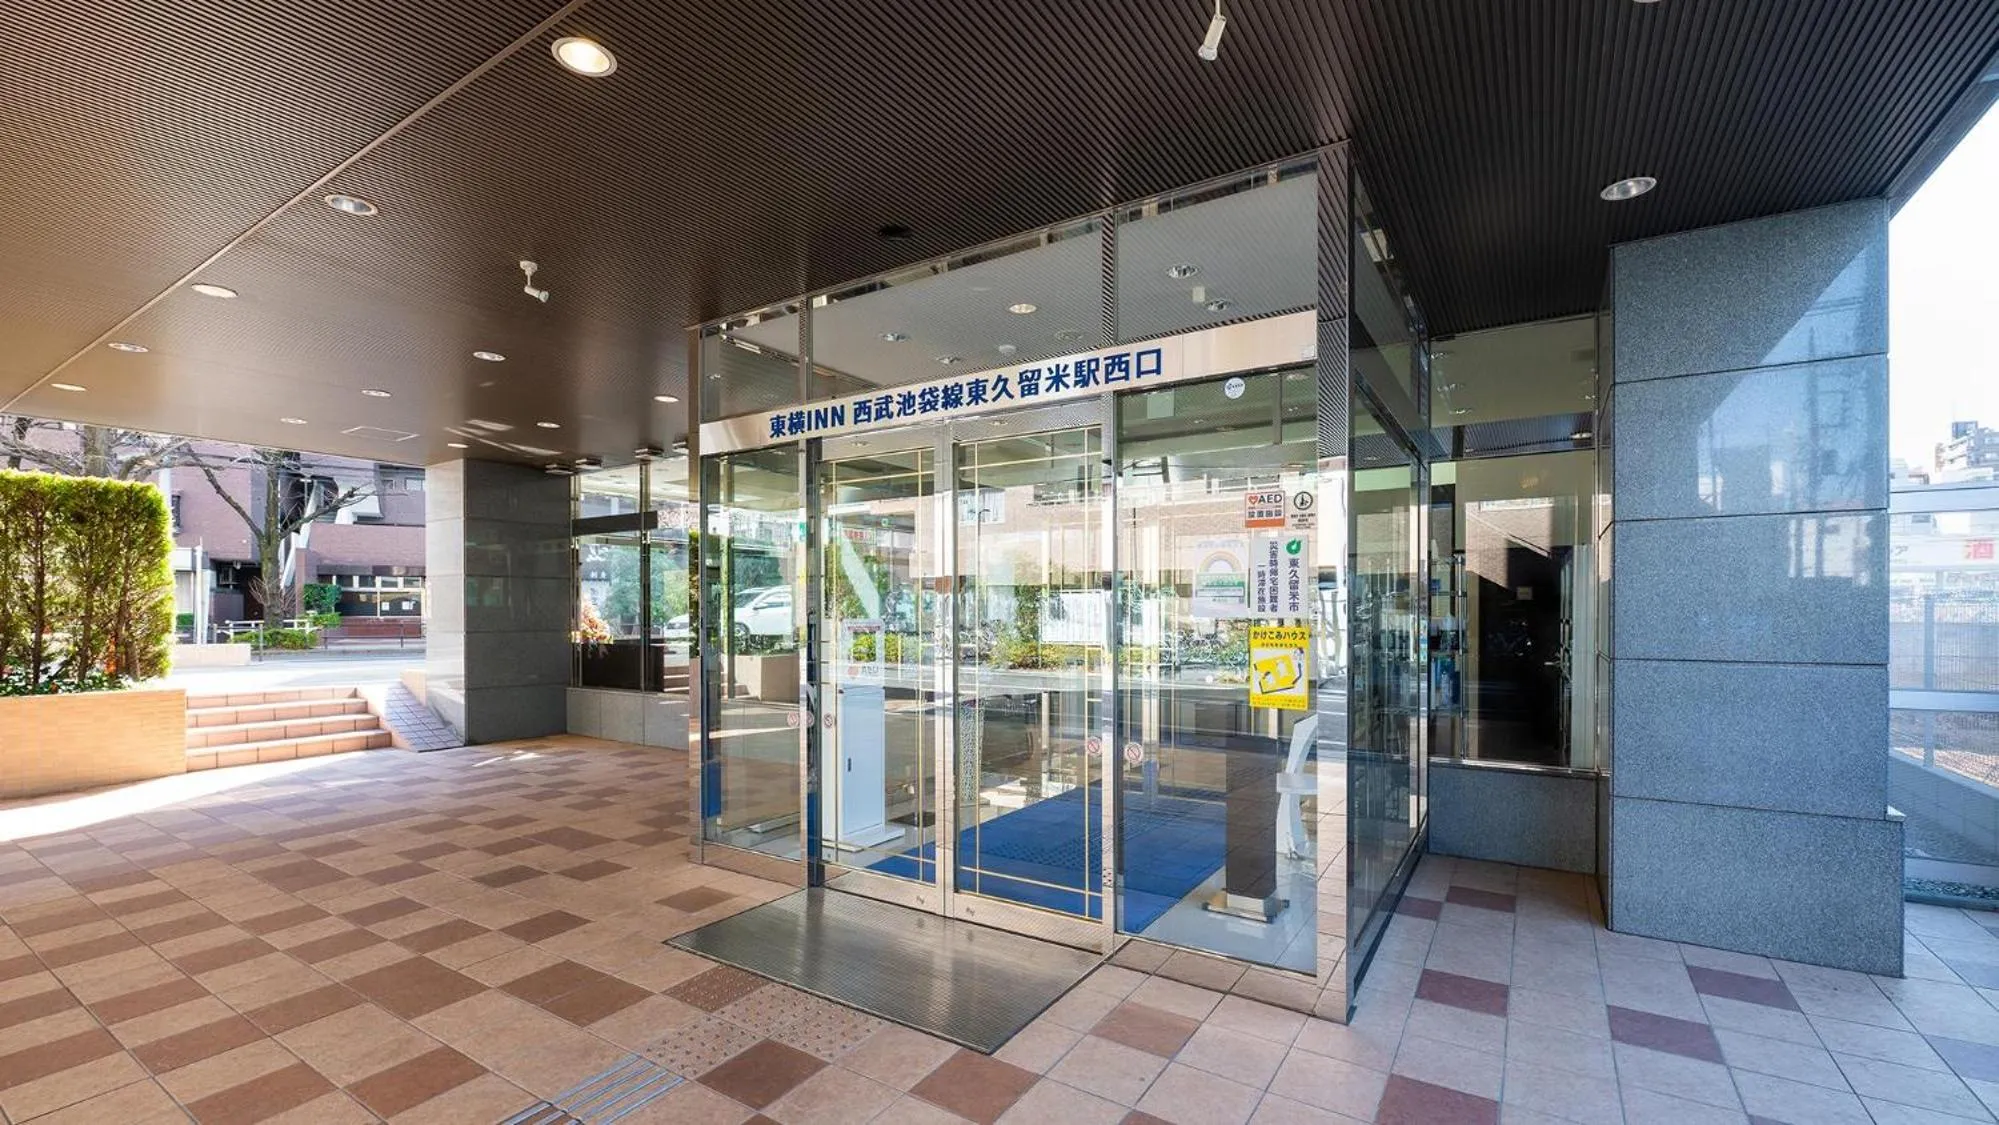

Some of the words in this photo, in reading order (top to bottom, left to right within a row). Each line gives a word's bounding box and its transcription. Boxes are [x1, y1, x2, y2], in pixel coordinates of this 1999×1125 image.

[769, 404, 845, 438] 東横INN
[853, 348, 1162, 425] 西武池袋線東久留米駅西口
[1258, 494, 1283, 504] AED
[1288, 558, 1300, 612] 東久留米市
[1253, 631, 1306, 640] かけこみハウス
